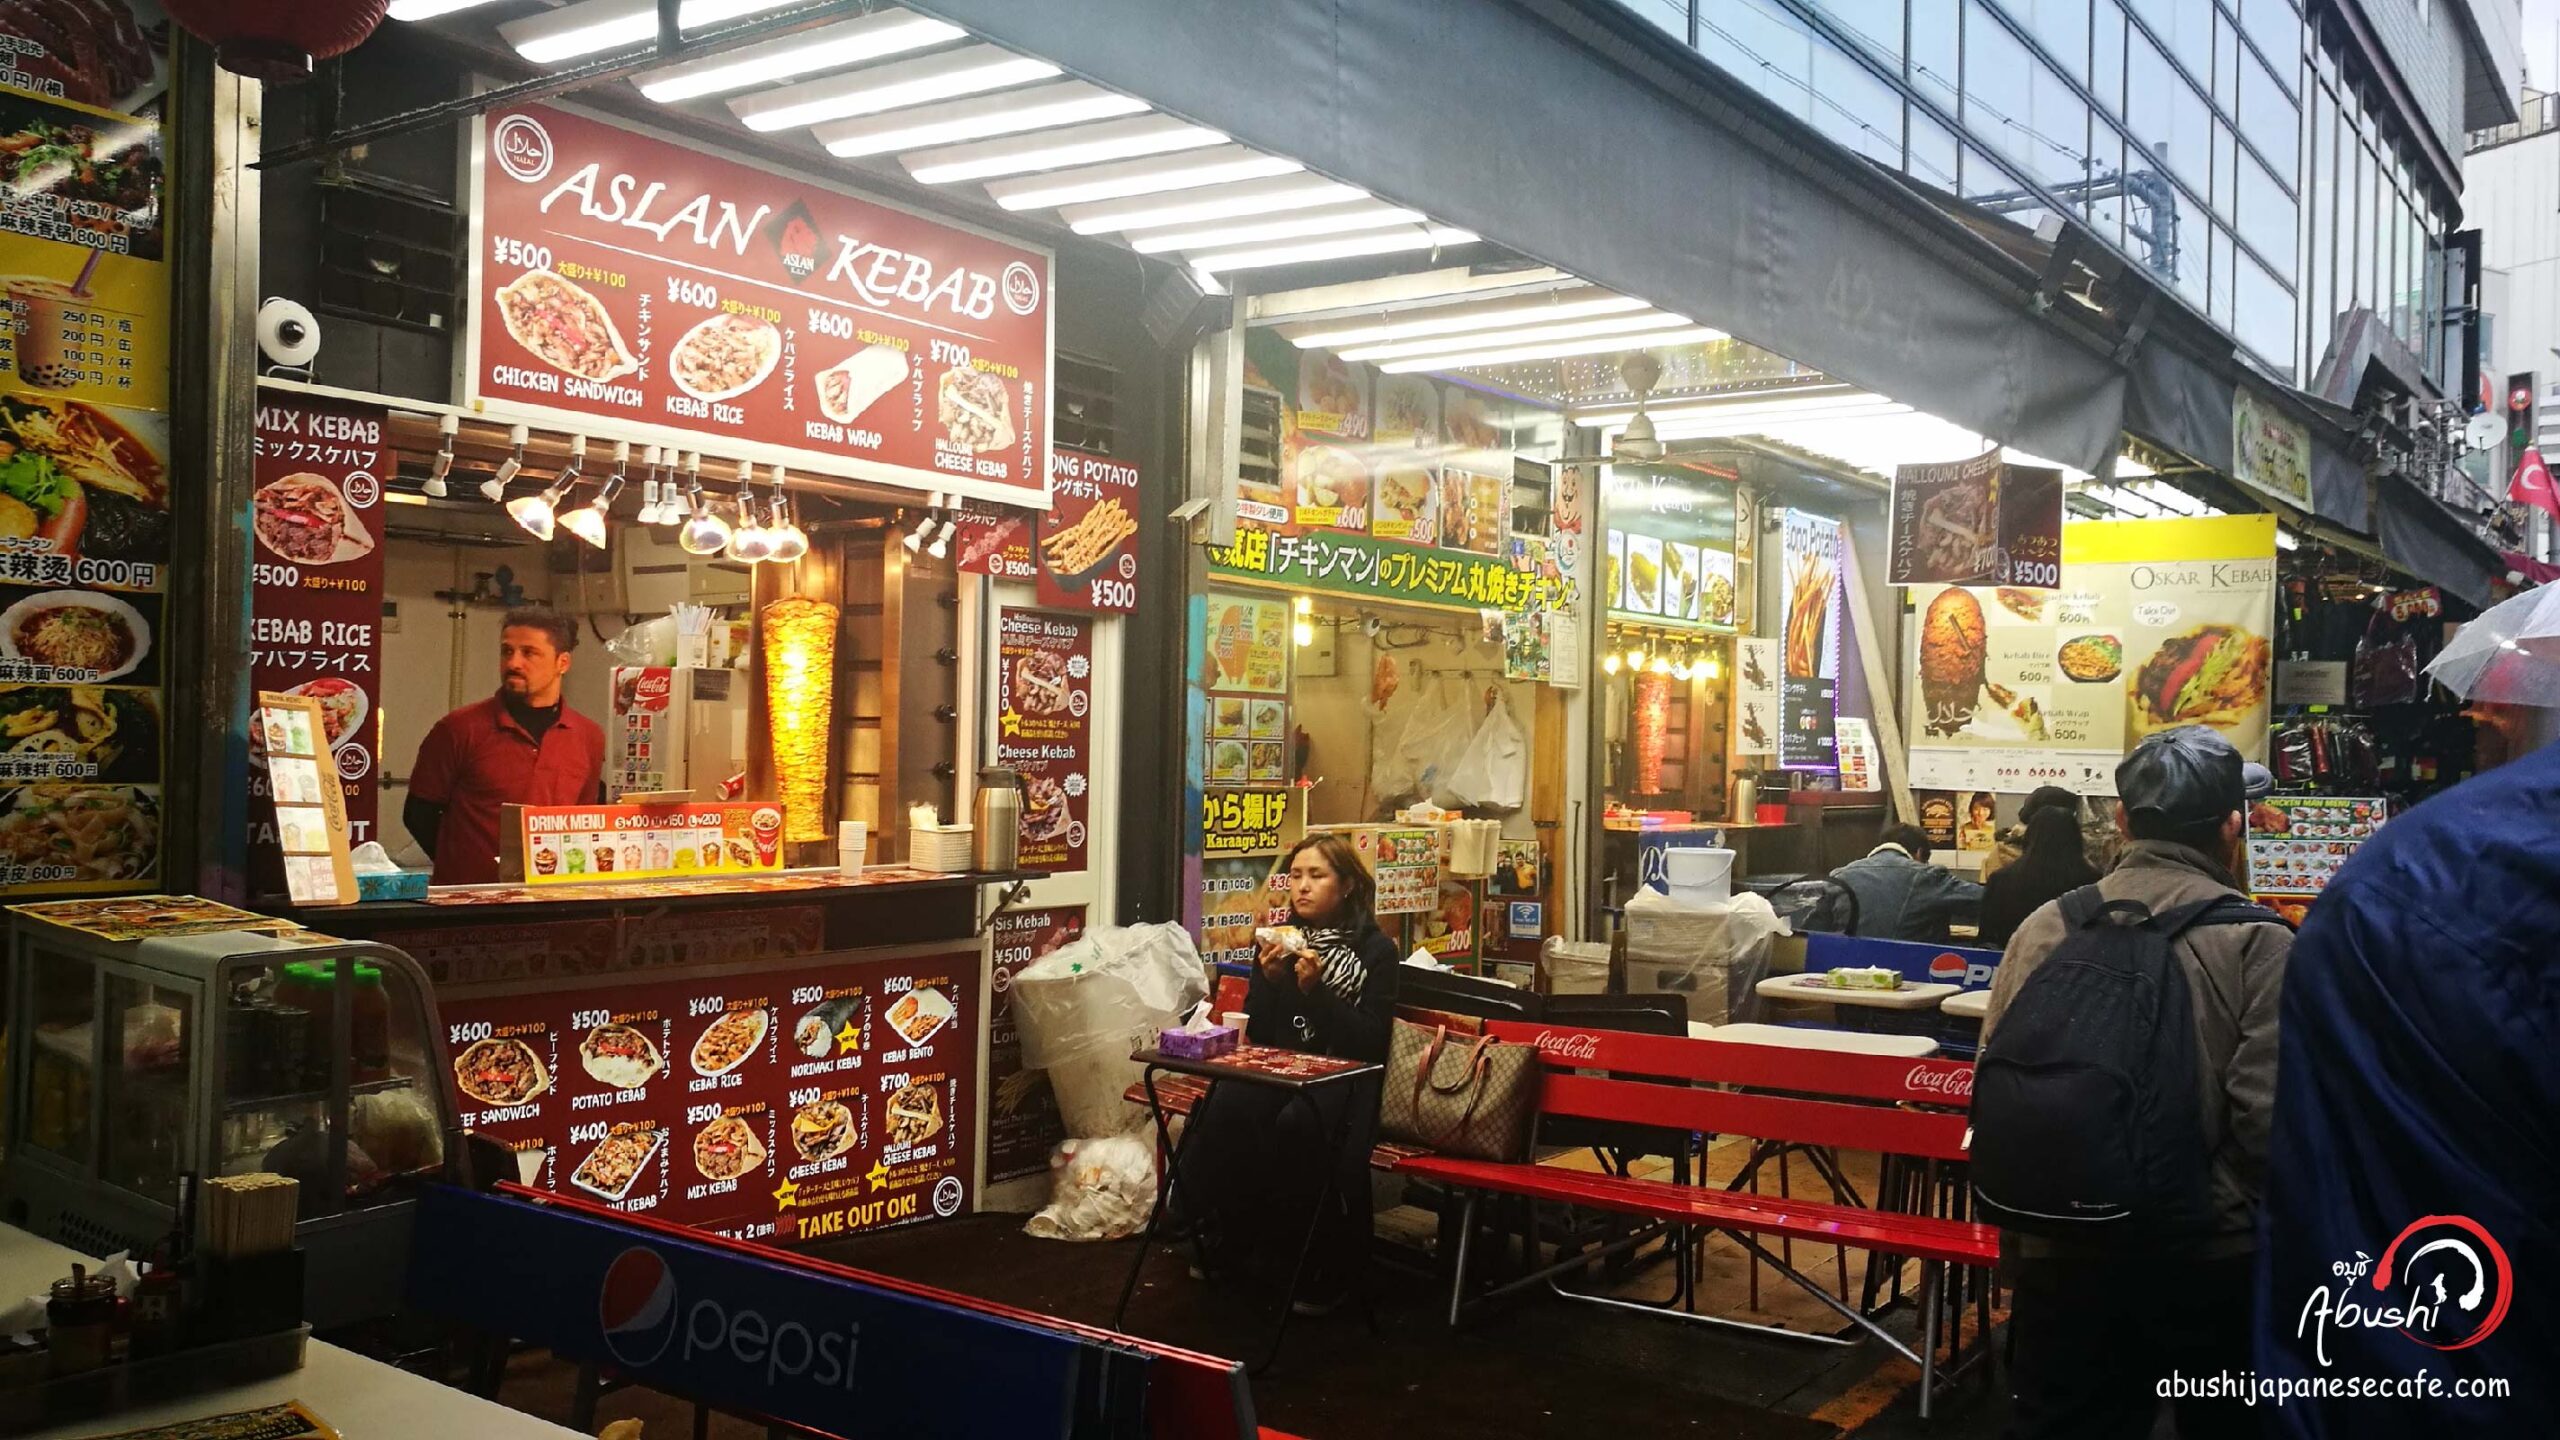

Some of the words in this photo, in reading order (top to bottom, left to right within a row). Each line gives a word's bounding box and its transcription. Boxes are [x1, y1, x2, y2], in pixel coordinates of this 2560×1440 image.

[494, 236, 552, 271] ¥500
[540, 163, 770, 255] ASLAN
[826, 234, 996, 320] KEBAB
[667, 276, 718, 309] ¥600
[808, 308, 853, 339] ¥600
[637, 294, 652, 381] チキンサンド
[930, 339, 970, 368] ¥700
[493, 365, 559, 393] CHICKEN
[565, 377, 643, 408] SANDWICH
[666, 395, 709, 418] KEBAB
[713, 403, 745, 425] RICE
[254, 406, 300, 435] MIX
[308, 413, 380, 444] KEBAB
[806, 421, 844, 444] KEBAB
[847, 427, 882, 450] WRAP
[934, 452, 974, 473] CHEESE
[976, 459, 1008, 478] KEBAB
[1052, 455, 1080, 477] ONG
[1084, 460, 1139, 488] POTATO
[1898, 465, 1960, 485] HALLOUMI
[1962, 456, 1989, 479] CHEESE
[1052, 478, 1103, 501] ングポテト
[1809, 521, 1839, 560] Potato
[1005, 560, 1030, 577] ¥500
[2014, 560, 2058, 586] ¥500
[2131, 565, 2200, 590] OSKAR
[2210, 563, 2273, 588] KEBAB
[1091, 578, 1136, 609] ¥500
[321, 621, 372, 648] RICE
[1000, 617, 1041, 634] Cheese
[1044, 621, 1078, 637] Kebab
[998, 744, 1039, 758] Cheese
[1041, 744, 1076, 759] Kebab
[529, 814, 569, 831] DRINK
[570, 813, 606, 830] MENU
[1204, 792, 1288, 830] から揚げ
[1206, 833, 1257, 851] Karaage
[1258, 832, 1278, 848] Pic
[995, 916, 1013, 931] Sis
[1016, 912, 1051, 930] Kebab
[994, 946, 1032, 965] ¥500
[792, 985, 823, 1005] ¥500
[884, 976, 913, 995] ¥600
[689, 996, 723, 1017] ¥600
[572, 1010, 610, 1031] ¥500
[450, 1021, 492, 1045] ¥600
[993, 1029, 1018, 1045] Lon
[1534, 1029, 1602, 1060] Coca-Cola
[882, 1049, 907, 1064] KEBAB
[909, 1045, 934, 1060] BENTO
[791, 1059, 834, 1079] NORIMAKI
[836, 1055, 862, 1071] KEBAB
[689, 1077, 718, 1092] KEBAB
[721, 1073, 743, 1089] RICE
[880, 1072, 910, 1093] ¥700
[1905, 1064, 1974, 1096] Coca-Col
[572, 1093, 613, 1111] POTATO
[616, 1087, 647, 1103] KEBAB
[789, 1086, 821, 1108] ¥600
[481, 1103, 541, 1125] SANDWICH
[687, 1103, 722, 1125] ¥500
[570, 1121, 608, 1145] ¥400
[883, 1149, 912, 1167] CHEESE
[913, 1144, 937, 1161] KEBAB
[789, 1161, 822, 1181] CHEESE
[822, 1156, 848, 1175] KEBAB
[687, 1184, 708, 1201] MIX
[709, 1178, 738, 1195] KEBAB
[627, 1195, 658, 1213] KEBAB
[797, 1210, 845, 1240] TAKE
[847, 1200, 885, 1228] OUT
[887, 1193, 917, 1219] OK!
[684, 1298, 861, 1391] pepsi
